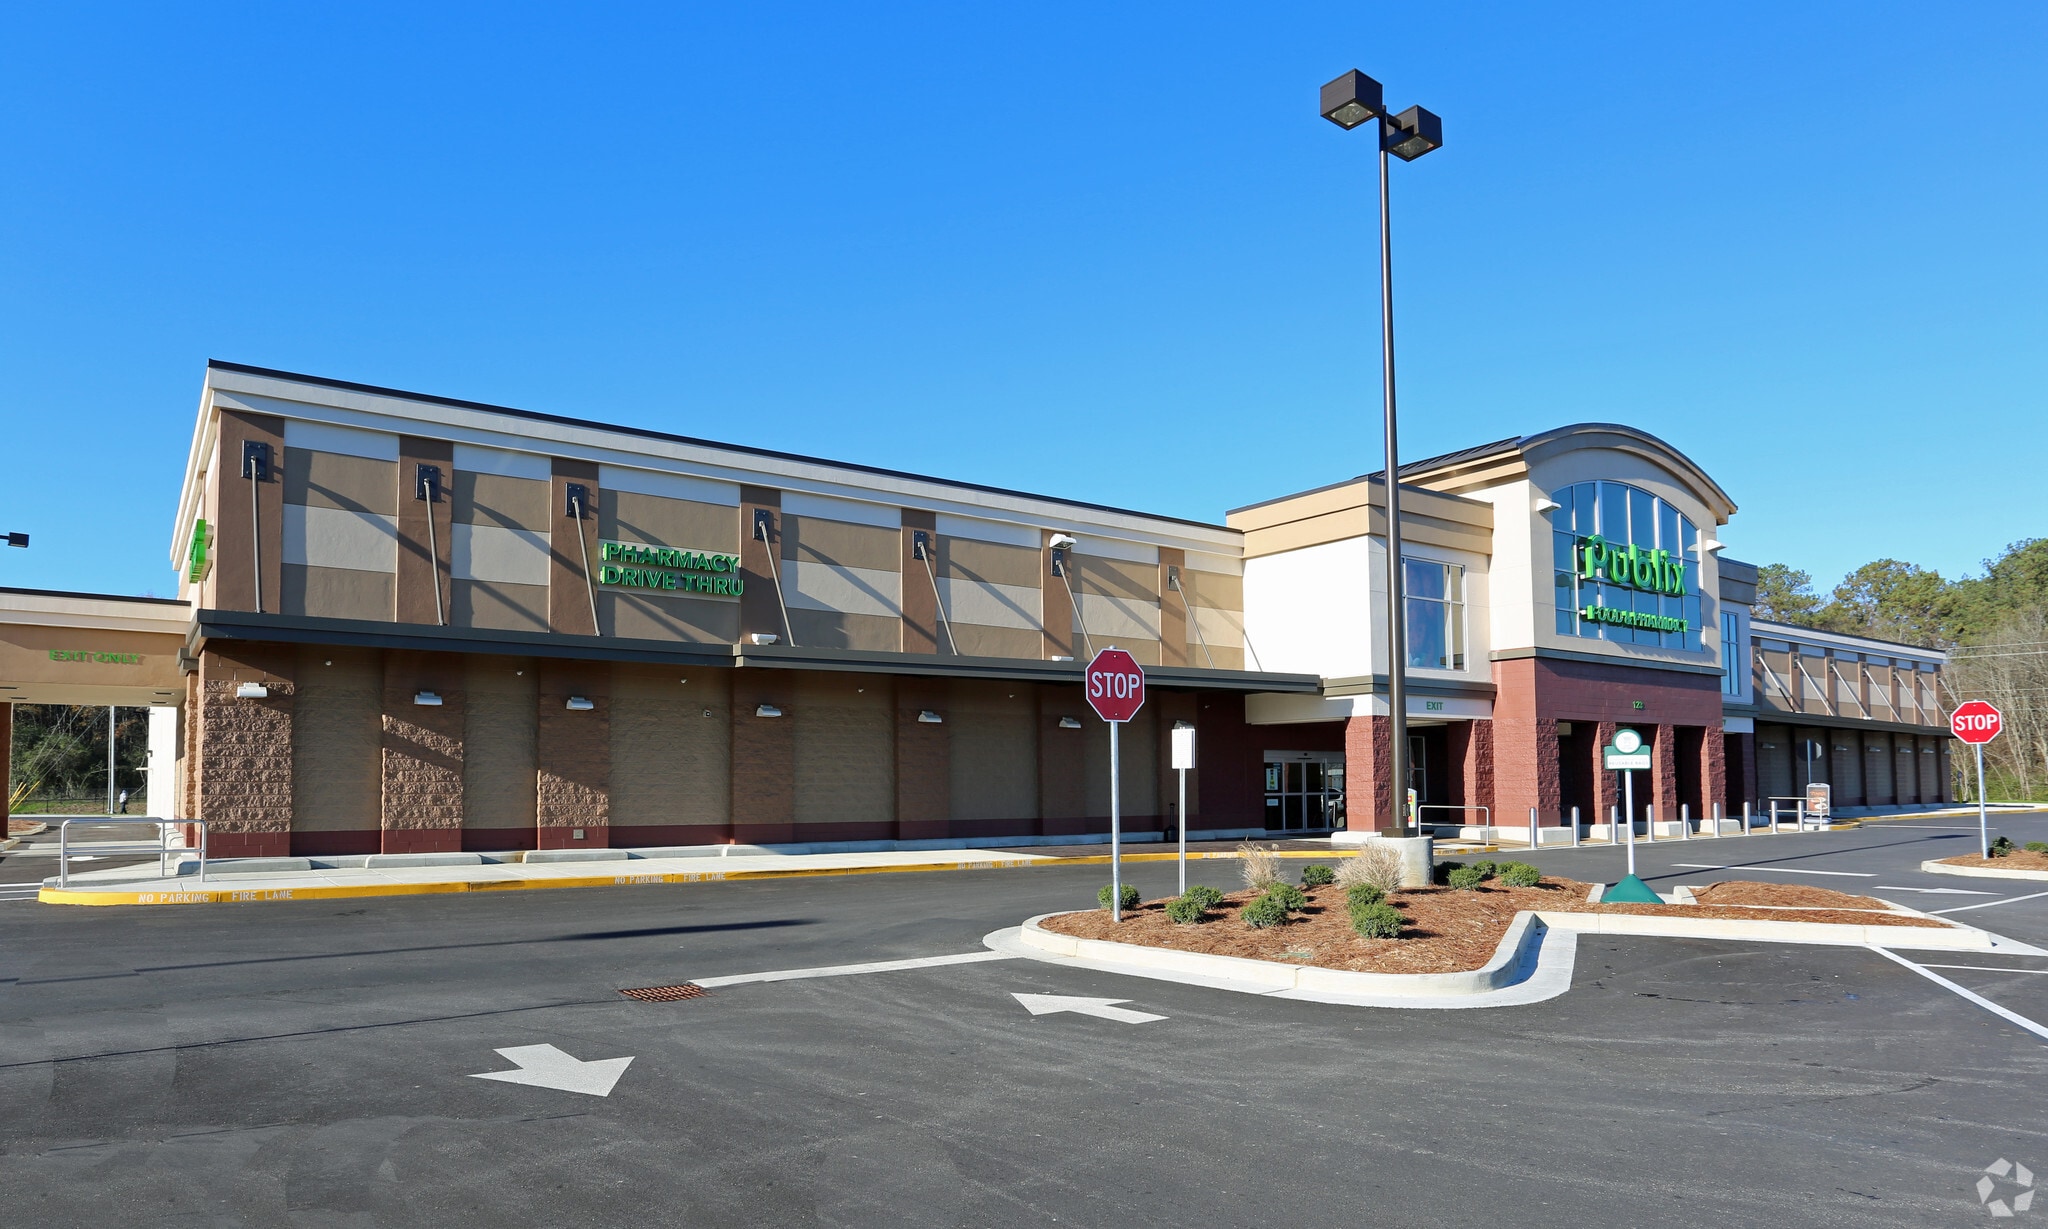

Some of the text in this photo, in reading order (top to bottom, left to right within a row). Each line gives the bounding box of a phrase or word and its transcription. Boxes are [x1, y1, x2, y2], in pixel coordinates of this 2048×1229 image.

[602, 542, 740, 573] PHARMACY
[1585, 534, 1687, 595] Publix
[601, 565, 744, 597] DRIVE THRU
[49, 649, 140, 665] EXIT ONLY
[1091, 671, 1140, 699] STOP
[1426, 701, 1443, 710] EXIT
[1955, 714, 1998, 731] STOP
[614, 872, 725, 884] NO PARKING FIRE LANE
[138, 889, 293, 903] NO PARKING FIRE LANE
